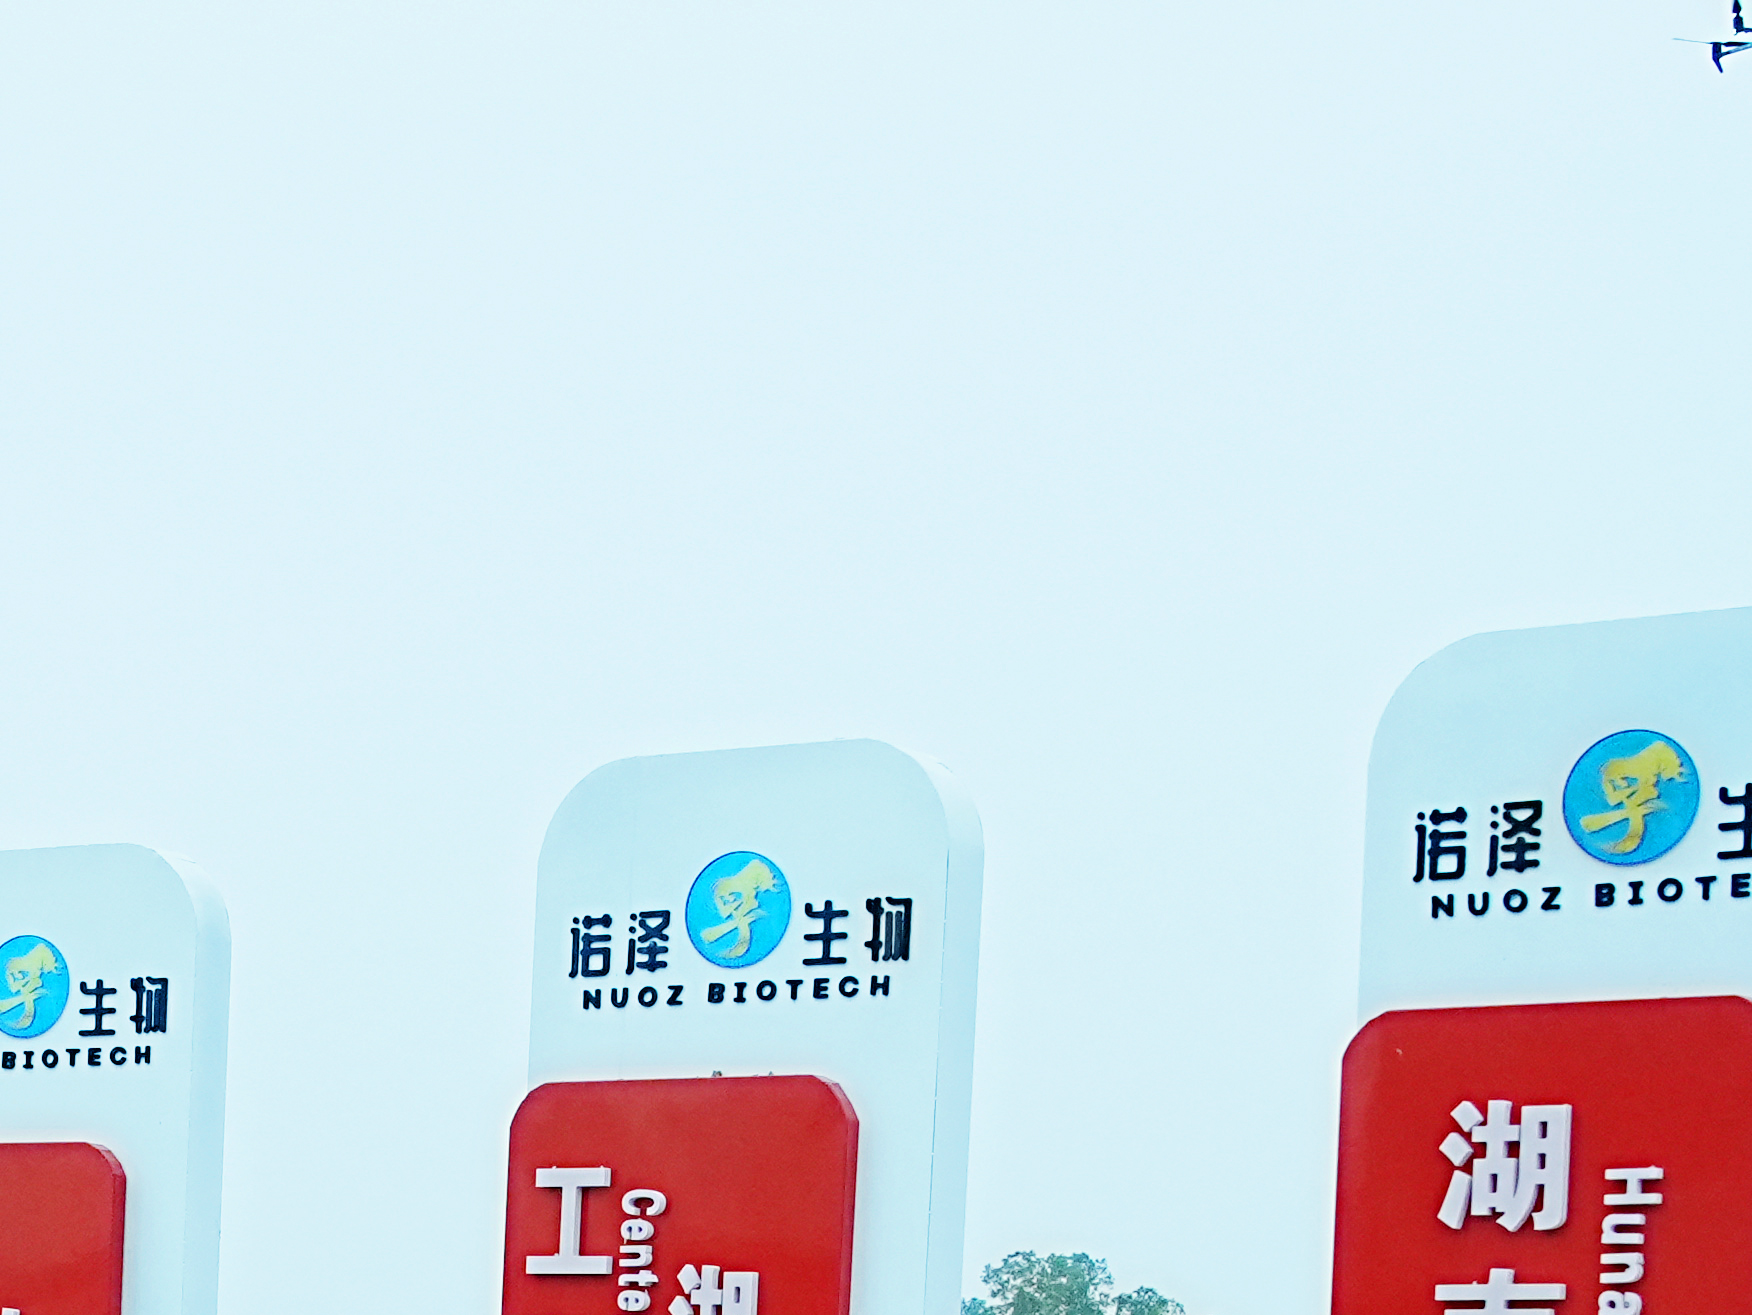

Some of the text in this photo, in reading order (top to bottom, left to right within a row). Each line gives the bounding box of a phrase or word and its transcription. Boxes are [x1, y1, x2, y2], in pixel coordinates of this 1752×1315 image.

[1432, 887, 1560, 918] NUOZ
[803, 897, 912, 965] 生物
[79, 977, 168, 1036] 生物
[583, 976, 889, 1009] NUOZ BIOTECH
[2, 1046, 150, 1069] BIOTECH
